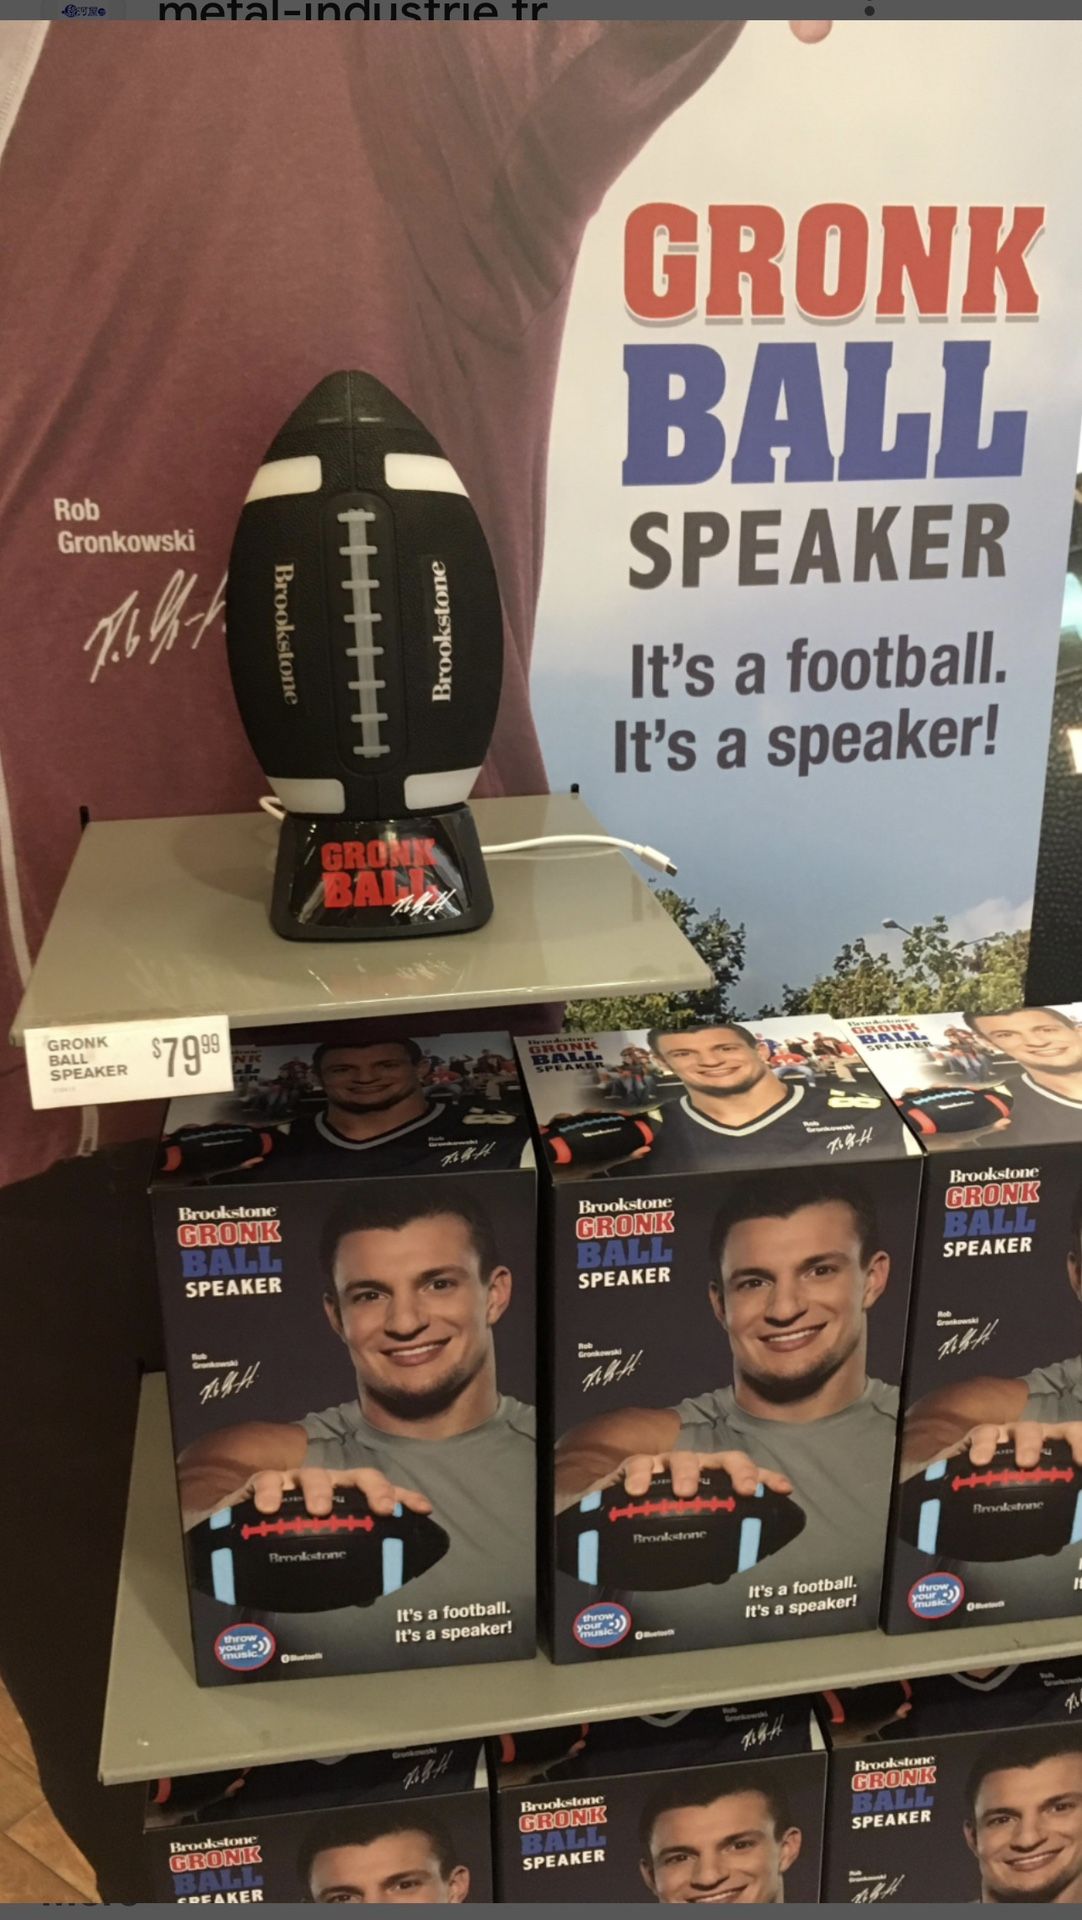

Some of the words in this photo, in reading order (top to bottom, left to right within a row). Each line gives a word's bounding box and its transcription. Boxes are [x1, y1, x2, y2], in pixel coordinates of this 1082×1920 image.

[623, 201, 1045, 322] GRONK
[622, 340, 1027, 486] BALL
[53, 497, 100, 521] Rob
[58, 529, 196, 554] Gronkowski
[629, 503, 1010, 590] SPEAKER
[274, 562, 298, 706] Brookstone
[432, 560, 452, 703] Brookstone
[631, 642, 715, 699] It's
[735, 652, 765, 696] a
[786, 630, 1006, 693] football.
[614, 717, 697, 774] It's
[716, 726, 746, 769] a
[766, 703, 999, 777] speaker!
[321, 837, 437, 872] GRONK
[322, 868, 439, 908] BALL
[851, 1023, 919, 1034] GRONK
[856, 1031, 928, 1045] BALL
[47, 1036, 109, 1051] GRONK
[528, 1042, 599, 1054] GRONK
[866, 1041, 934, 1051] SPEAKER
[48, 1053, 89, 1067] BALL
[531, 1051, 603, 1066] BALL
[536, 1062, 605, 1073] SPEAKER
[50, 1064, 128, 1082] SPEAKER
[949, 1166, 1040, 1184] Brookstone
[578, 1197, 672, 1214] Brookstone
[945, 1180, 1041, 1209] GRONK
[178, 1205, 277, 1221] Brookstone
[943, 1206, 1036, 1238] BALL
[177, 1220, 282, 1247] GRONK
[576, 1210, 675, 1240] GRONK
[576, 1236, 673, 1269] BALL
[943, 1237, 1032, 1258] SPEAKER
[181, 1246, 282, 1277] BALL
[185, 1277, 282, 1298] SPEAKER
[578, 1267, 670, 1289] SPEAKER
[973, 1501, 1044, 1514] Brookstone
[633, 1530, 707, 1544] Brookstone
[268, 1551, 347, 1563] Brookstone
[748, 1585, 773, 1598] It's
[778, 1585, 788, 1596] a
[793, 1575, 857, 1594] football.
[912, 1591, 936, 1603] your
[918, 1583, 949, 1592] throw
[398, 1608, 423, 1623] It's
[428, 1609, 438, 1620] a
[443, 1601, 511, 1619] football.
[745, 1604, 770, 1618] It's
[774, 1604, 784, 1615] a
[788, 1593, 857, 1616] speaker!
[577, 1622, 602, 1632] your
[582, 1613, 615, 1622] throw
[224, 1635, 258, 1644] throw
[395, 1629, 421, 1643] It's
[426, 1630, 436, 1640] a
[441, 1620, 512, 1641] speaker!
[218, 1643, 246, 1655] your
[855, 1756, 935, 1772] Brookstone
[852, 1766, 936, 1792] GRONK
[520, 1796, 604, 1813] Brookstone
[851, 1786, 934, 1814] BALL
[519, 1805, 607, 1833] GRONK
[851, 1809, 931, 1829] SPEAKER
[169, 1836, 258, 1853] Brookstone
[520, 1826, 607, 1856] BALL
[169, 1845, 263, 1873] GRONK
[523, 1849, 605, 1871] SPEAKER
[173, 1866, 263, 1896] BALL
